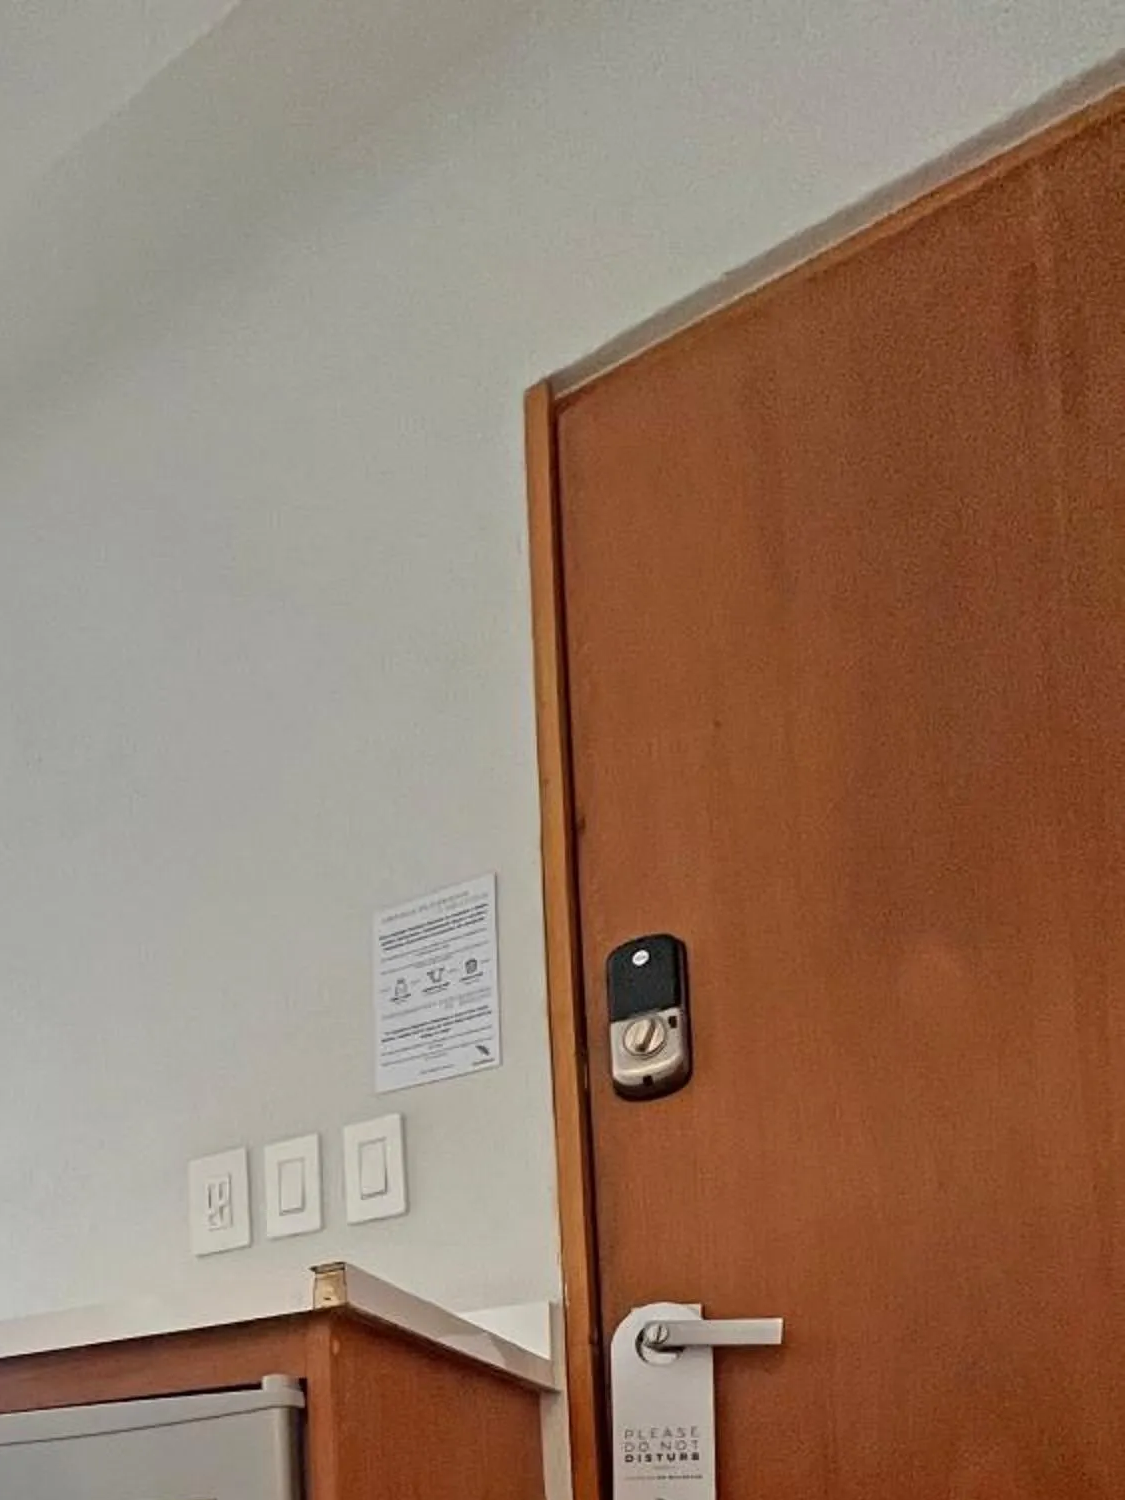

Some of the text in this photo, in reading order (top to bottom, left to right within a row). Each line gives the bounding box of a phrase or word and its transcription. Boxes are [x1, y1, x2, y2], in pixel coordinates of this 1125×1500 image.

[624, 1426, 700, 1440] PLEASE
[624, 1440, 699, 1453] DO NOT
[624, 1452, 700, 1463] DISTURB
